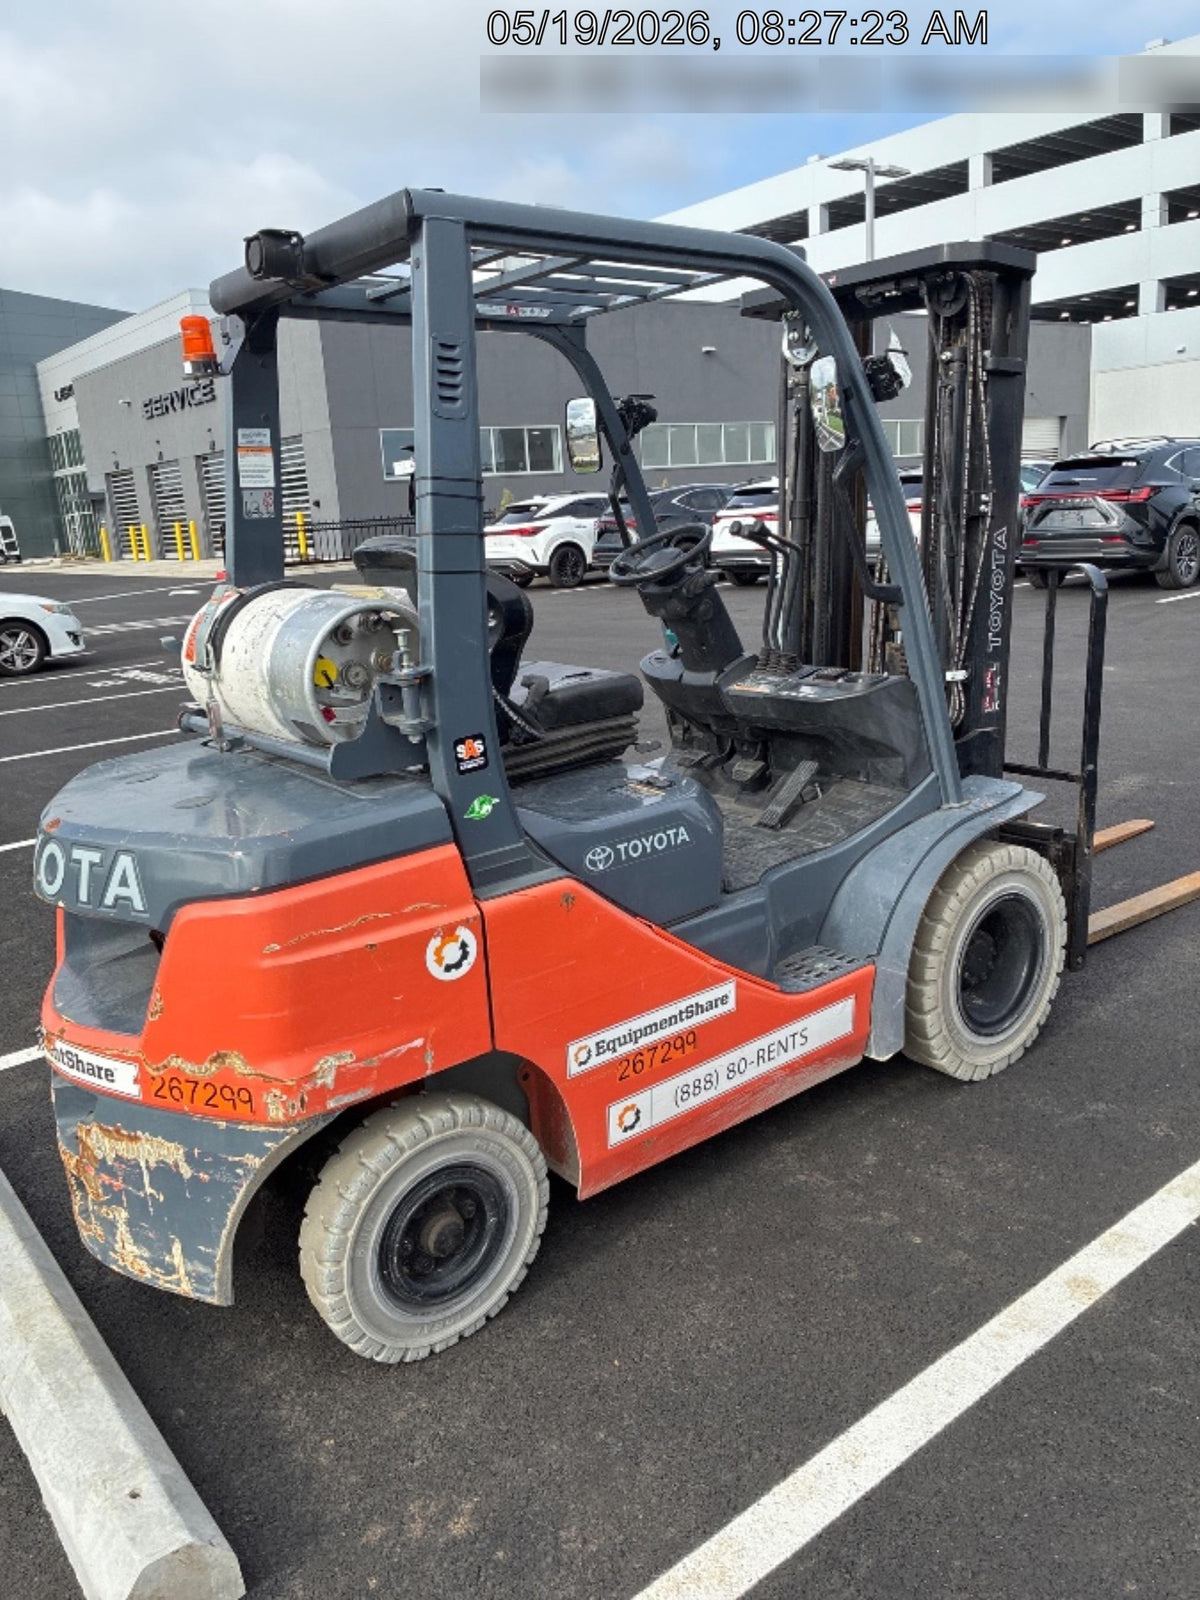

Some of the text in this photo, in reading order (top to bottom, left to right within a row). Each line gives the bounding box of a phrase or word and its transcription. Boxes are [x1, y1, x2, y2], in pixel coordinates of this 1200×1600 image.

[142, 380, 216, 420] SERVICE
[988, 526, 1008, 654] TOYOTA
[616, 825, 691, 862] TOYOTA
[39, 842, 145, 911] OTA
[594, 992, 730, 1056] EquipmentShare
[618, 1030, 698, 1081] 267299
[673, 1027, 809, 1108] (888) 80-RENTS
[153, 1076, 256, 1115] 267299
